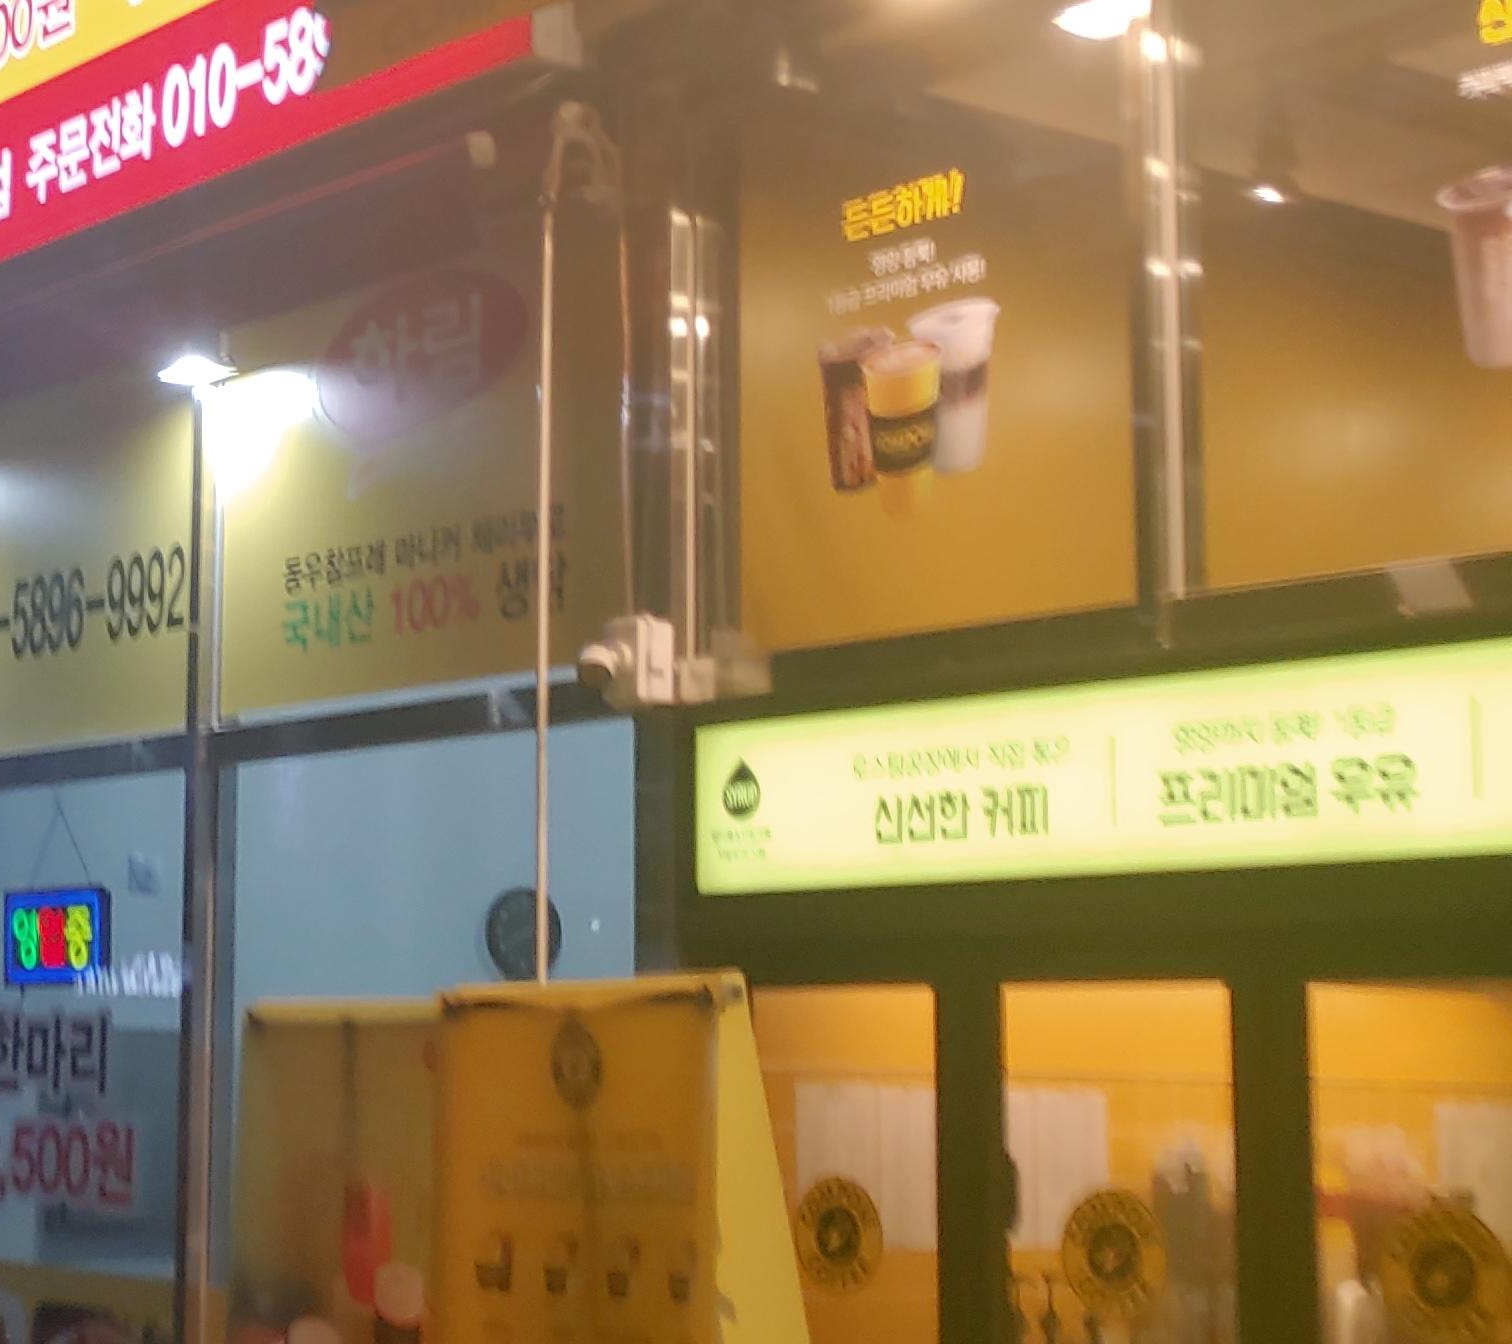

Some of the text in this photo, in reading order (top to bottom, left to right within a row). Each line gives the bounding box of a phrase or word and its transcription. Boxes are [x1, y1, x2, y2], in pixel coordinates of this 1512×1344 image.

[26, 81, 157, 204] 주문전화
[282, 589, 375, 653] 국내산
[392, 570, 481, 635] 100%
[874, 784, 1051, 845] 신선한 커피
[1157, 752, 1420, 828] 프리미엄 우유
